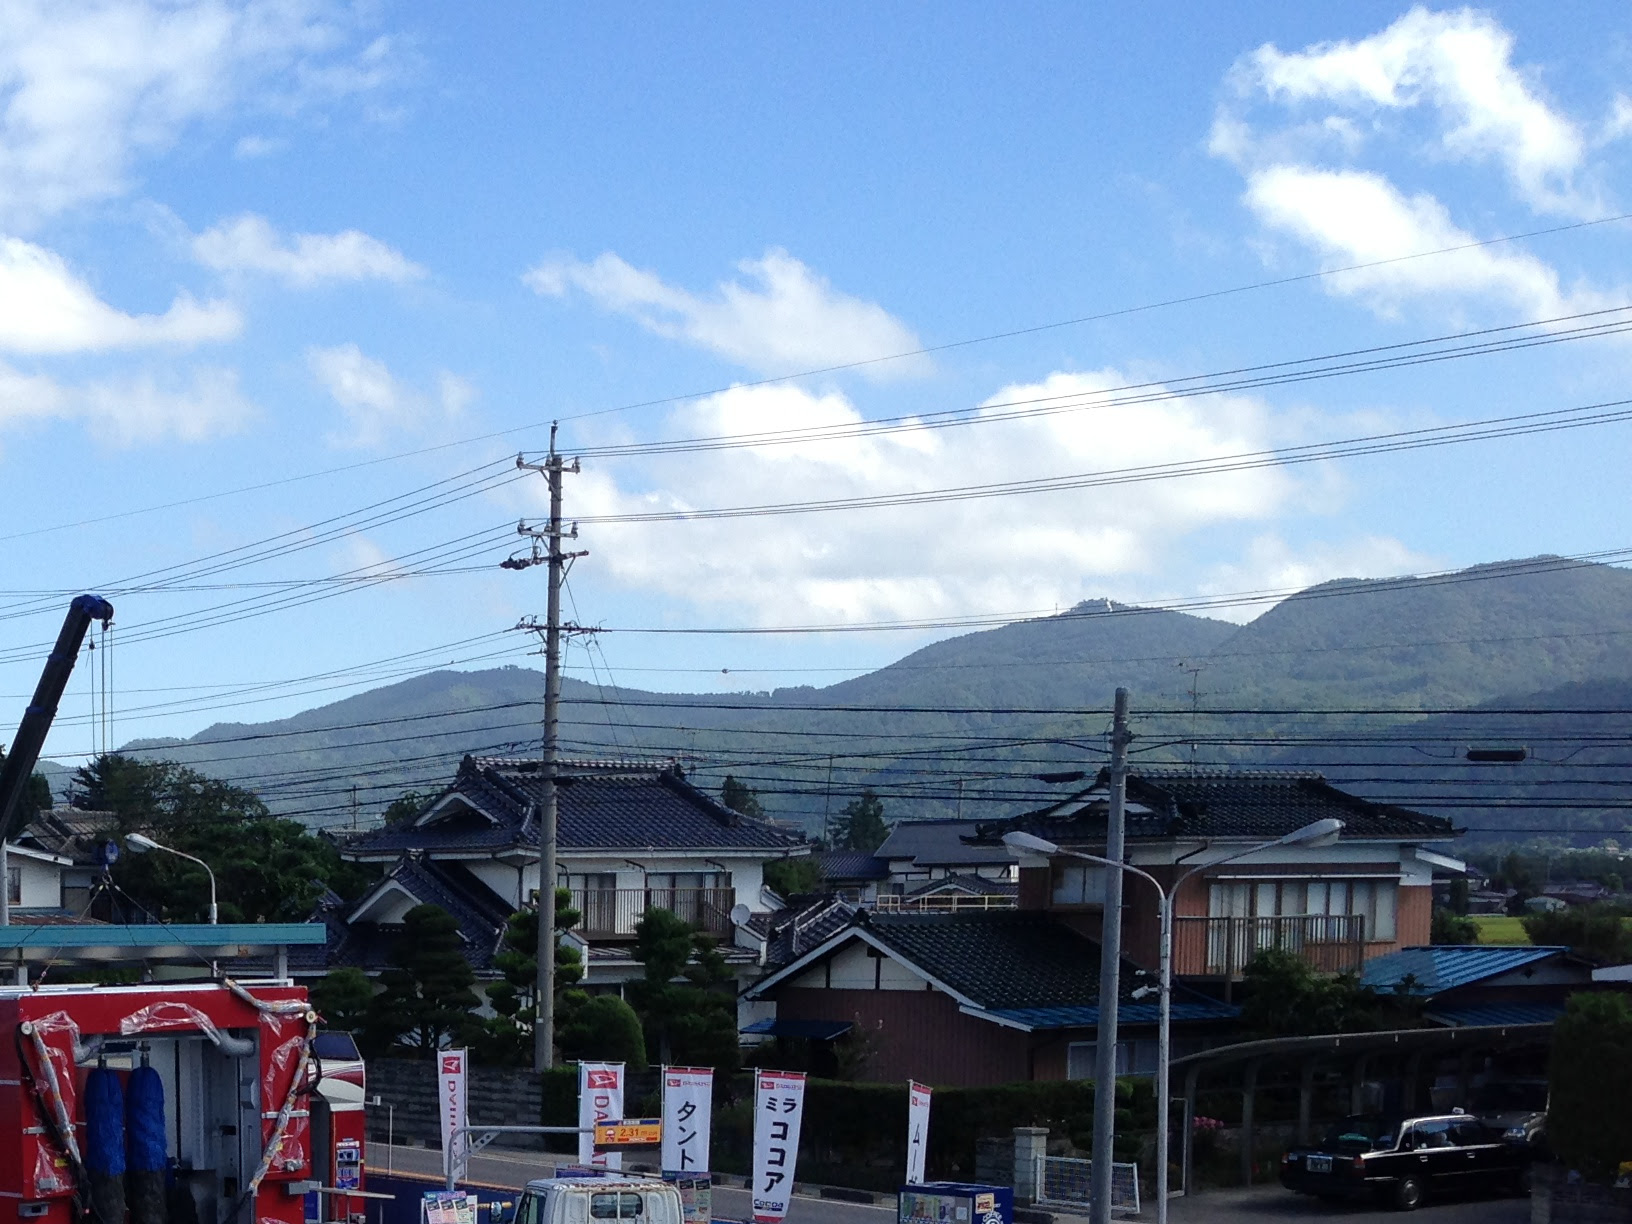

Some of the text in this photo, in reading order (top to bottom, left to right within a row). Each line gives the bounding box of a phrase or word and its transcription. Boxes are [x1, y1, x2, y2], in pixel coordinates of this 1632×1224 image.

[677, 1100, 697, 1171] タント
[765, 1096, 797, 1114] ミラ
[764, 1121, 789, 1193] ココア
